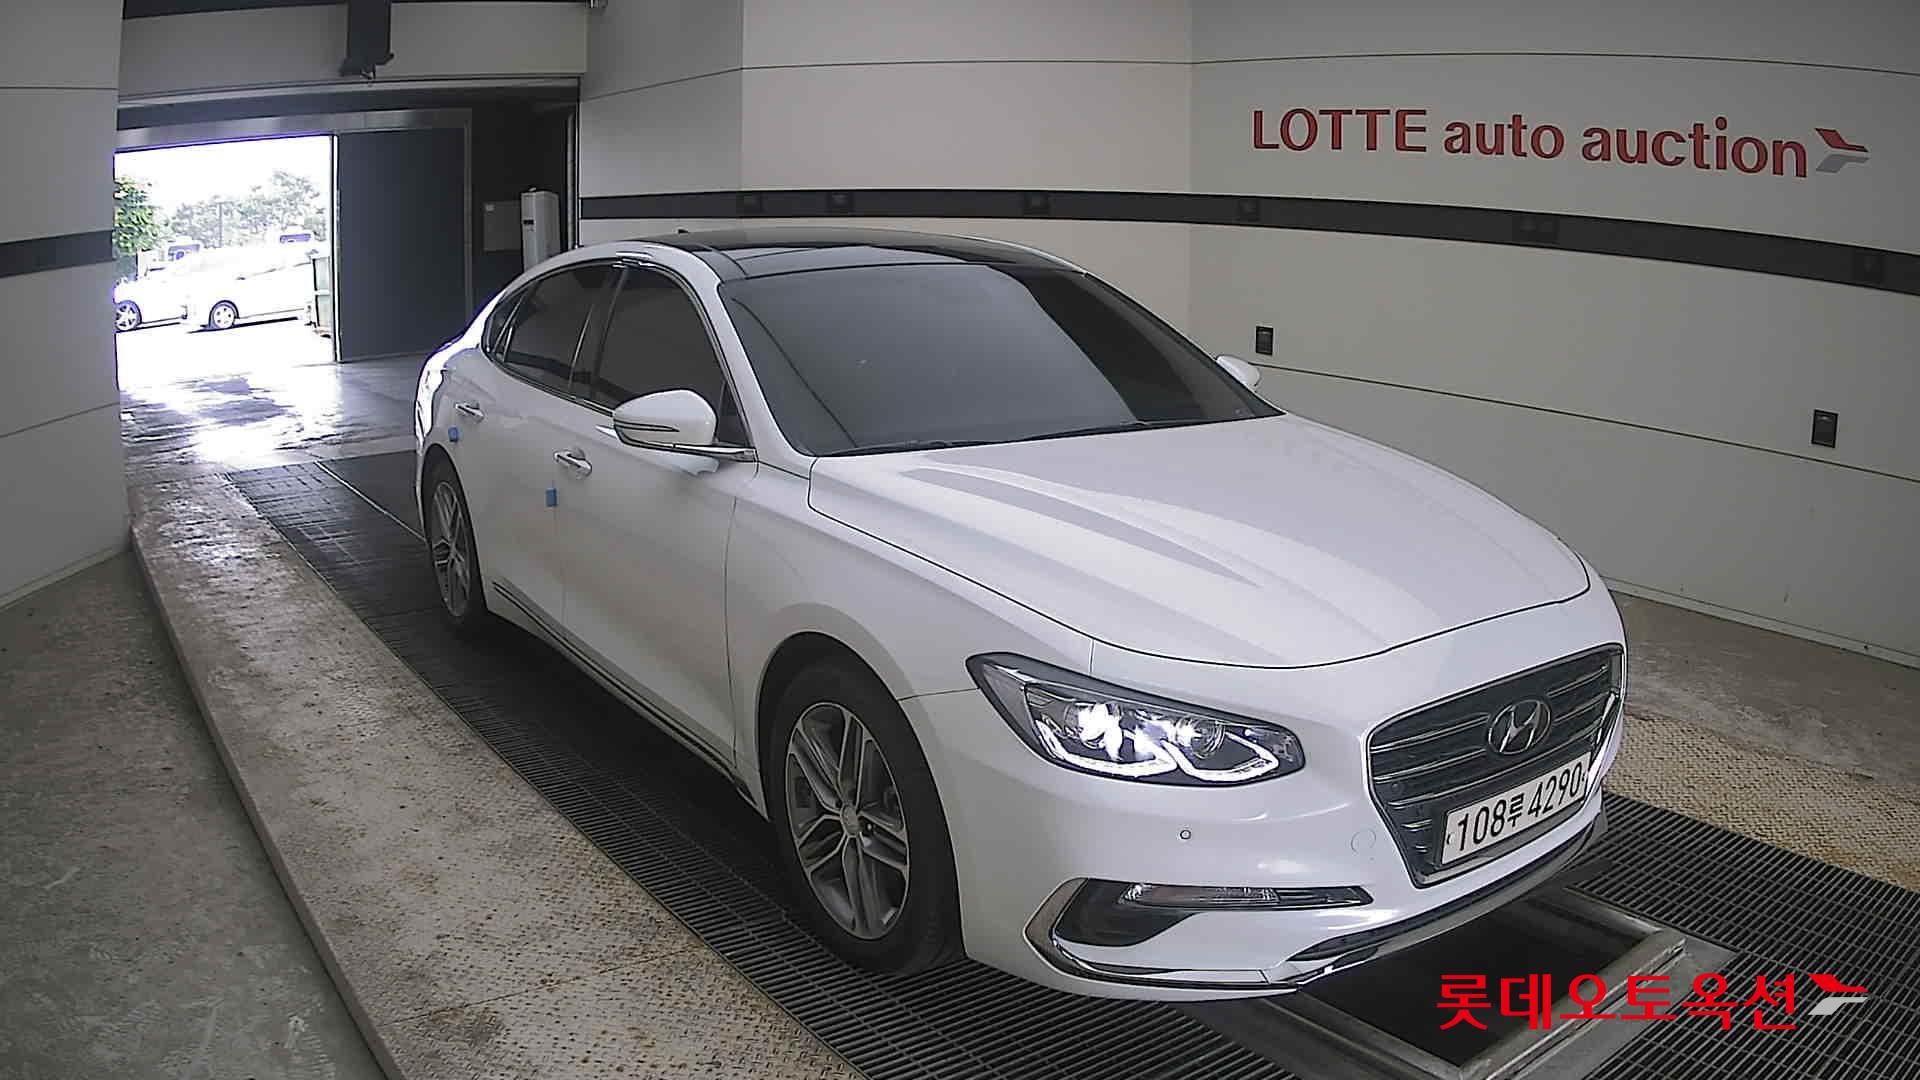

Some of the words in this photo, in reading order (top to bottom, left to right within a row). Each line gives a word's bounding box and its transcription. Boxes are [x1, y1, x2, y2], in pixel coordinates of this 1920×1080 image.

[1252, 109, 1428, 152] LOTTE
[1443, 114, 1565, 158] auto
[1581, 116, 1808, 178] auction
[1527, 761, 1582, 818] 4290
